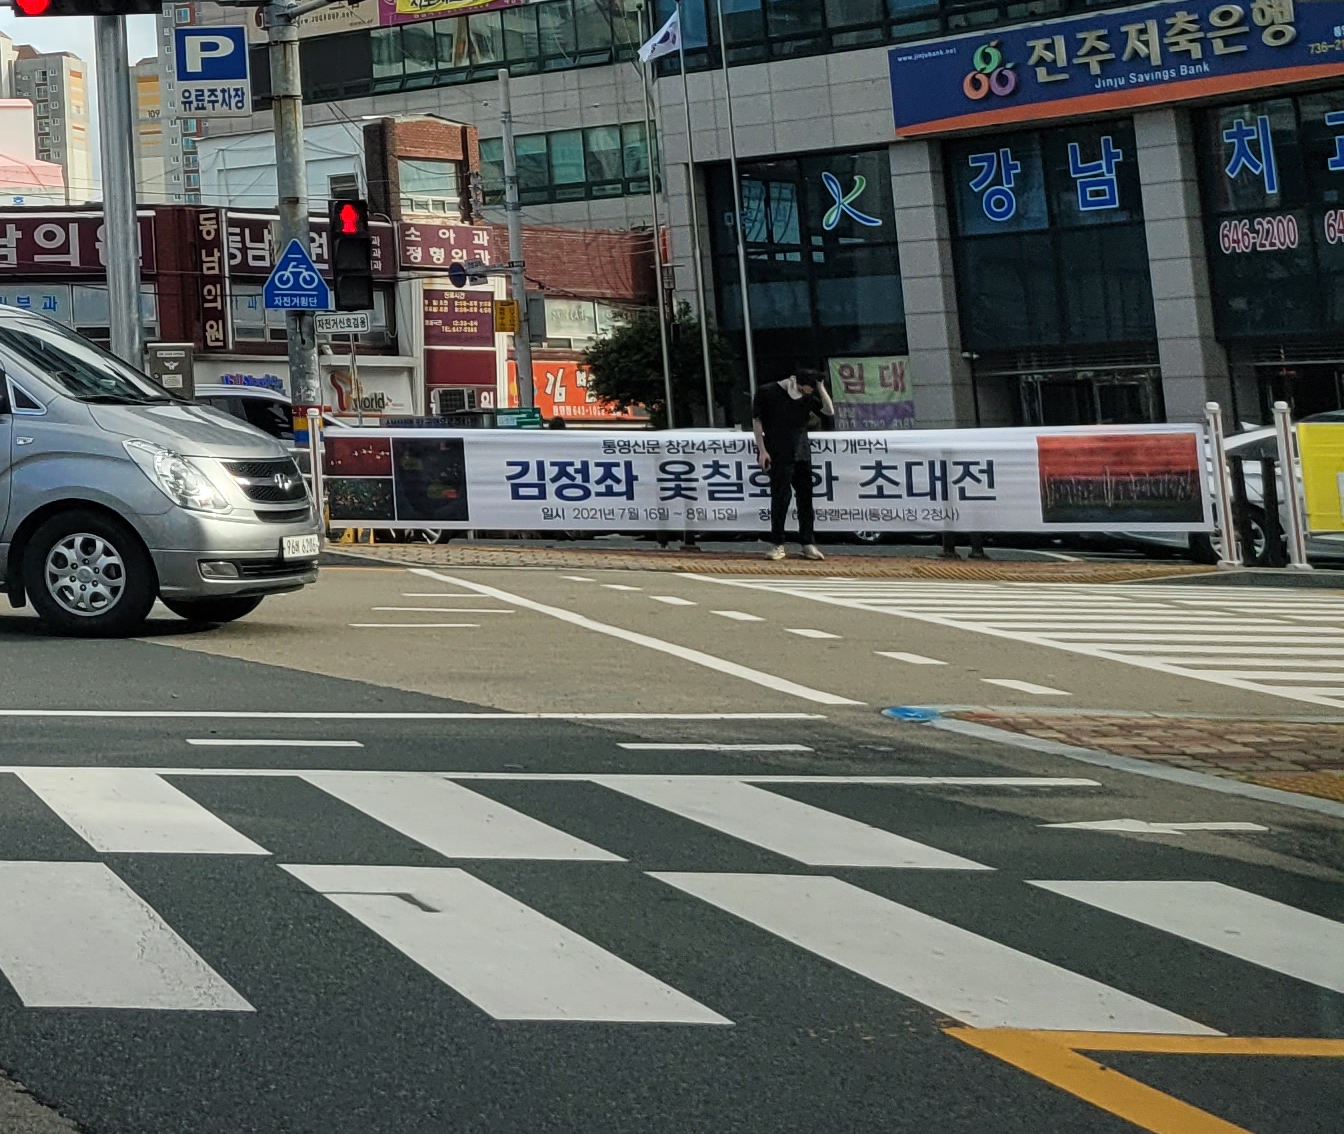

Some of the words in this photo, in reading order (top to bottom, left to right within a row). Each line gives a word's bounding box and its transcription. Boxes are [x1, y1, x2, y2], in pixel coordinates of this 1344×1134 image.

[185, 35, 234, 73] P
[1095, 73, 1125, 89] Jinju
[1129, 68, 1177, 85] Savings
[1180, 62, 1210, 77] Bank
[181, 87, 245, 112] 유료주차장
[1220, 215, 1298, 254] 646-2200
[199, 213, 224, 348] 동남의원
[274, 296, 317, 307] 자전거횡단
[602, 439, 661, 455] 통영신문
[842, 439, 888, 454] 개막식
[505, 459, 638, 502] 김정좌
[859, 459, 996, 502] 초대전
[541, 507, 565, 521] 일시
[573, 507, 615, 521] 2021년
[618, 508, 640, 521] 7월
[644, 507, 670, 522] 16일
[712, 507, 738, 521] 15일
[922, 508, 959, 522] 2청사)
